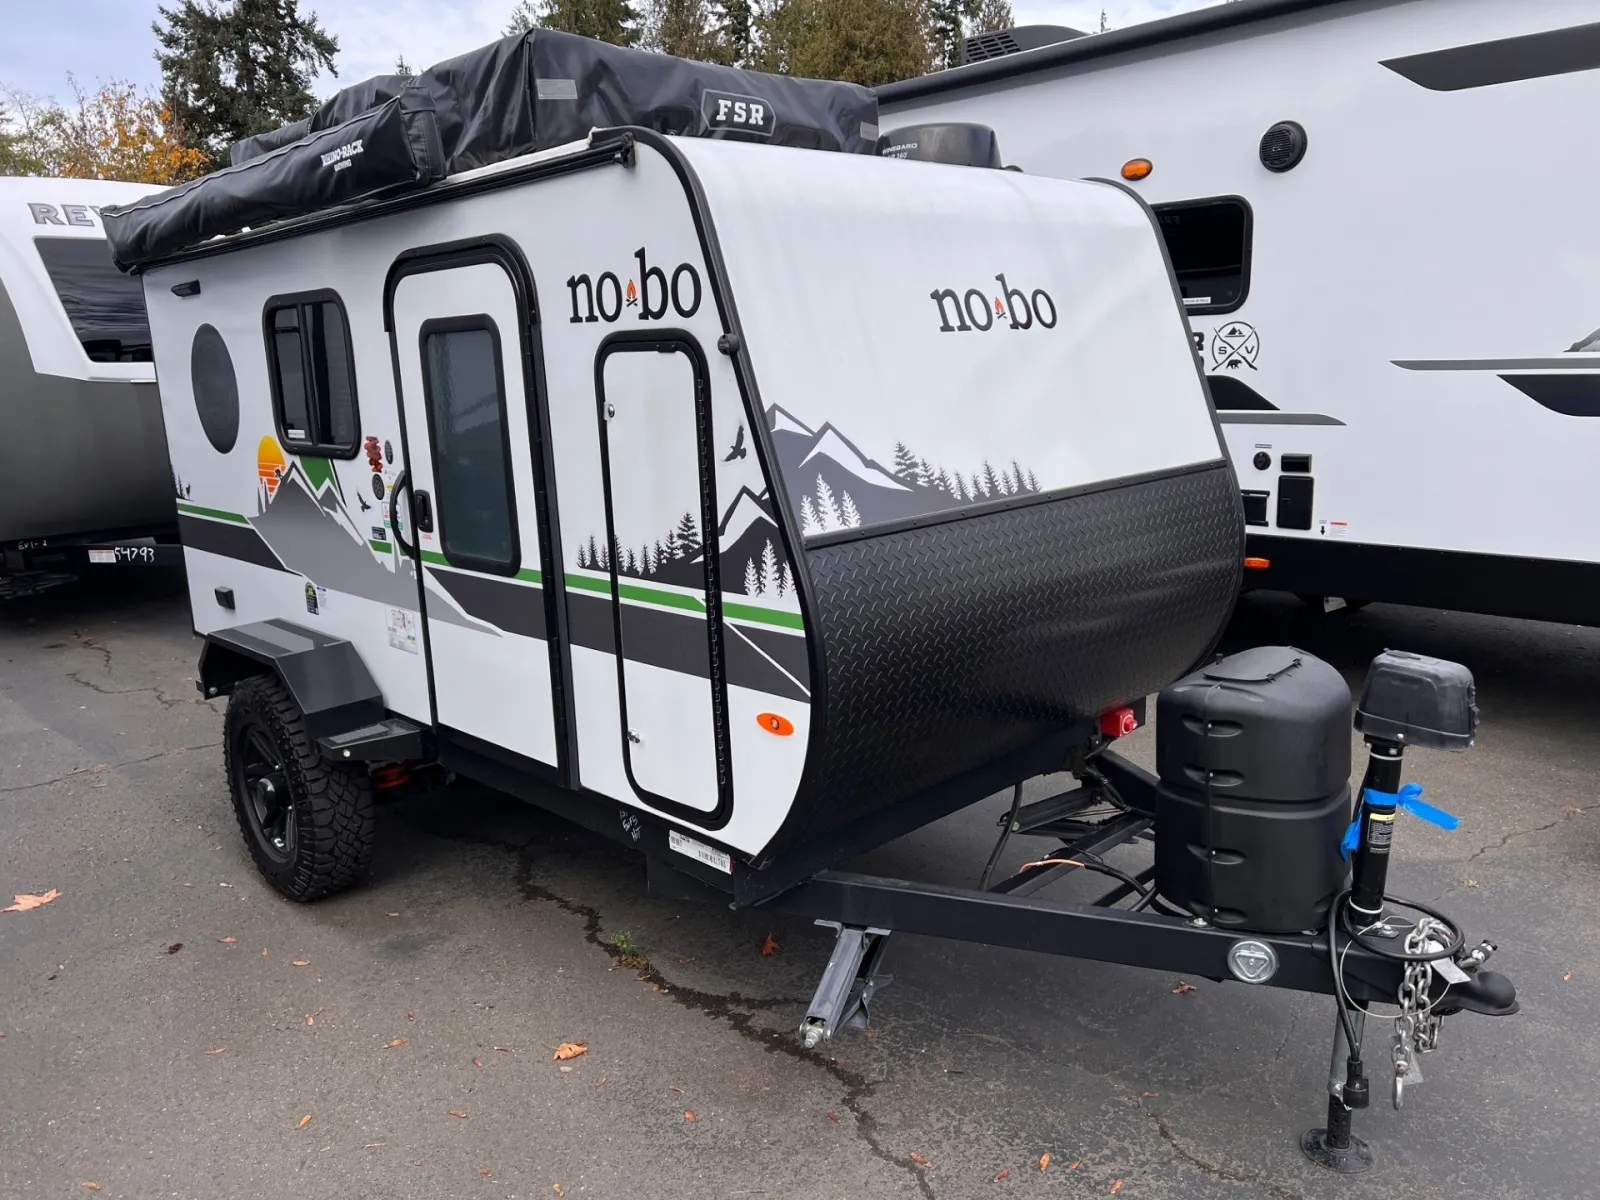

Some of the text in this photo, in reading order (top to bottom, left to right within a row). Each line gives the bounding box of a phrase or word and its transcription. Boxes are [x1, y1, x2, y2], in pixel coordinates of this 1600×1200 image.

[716, 99, 764, 125] FSR
[1218, 345, 1255, 355] S V
[114, 546, 155, 562] 54793
